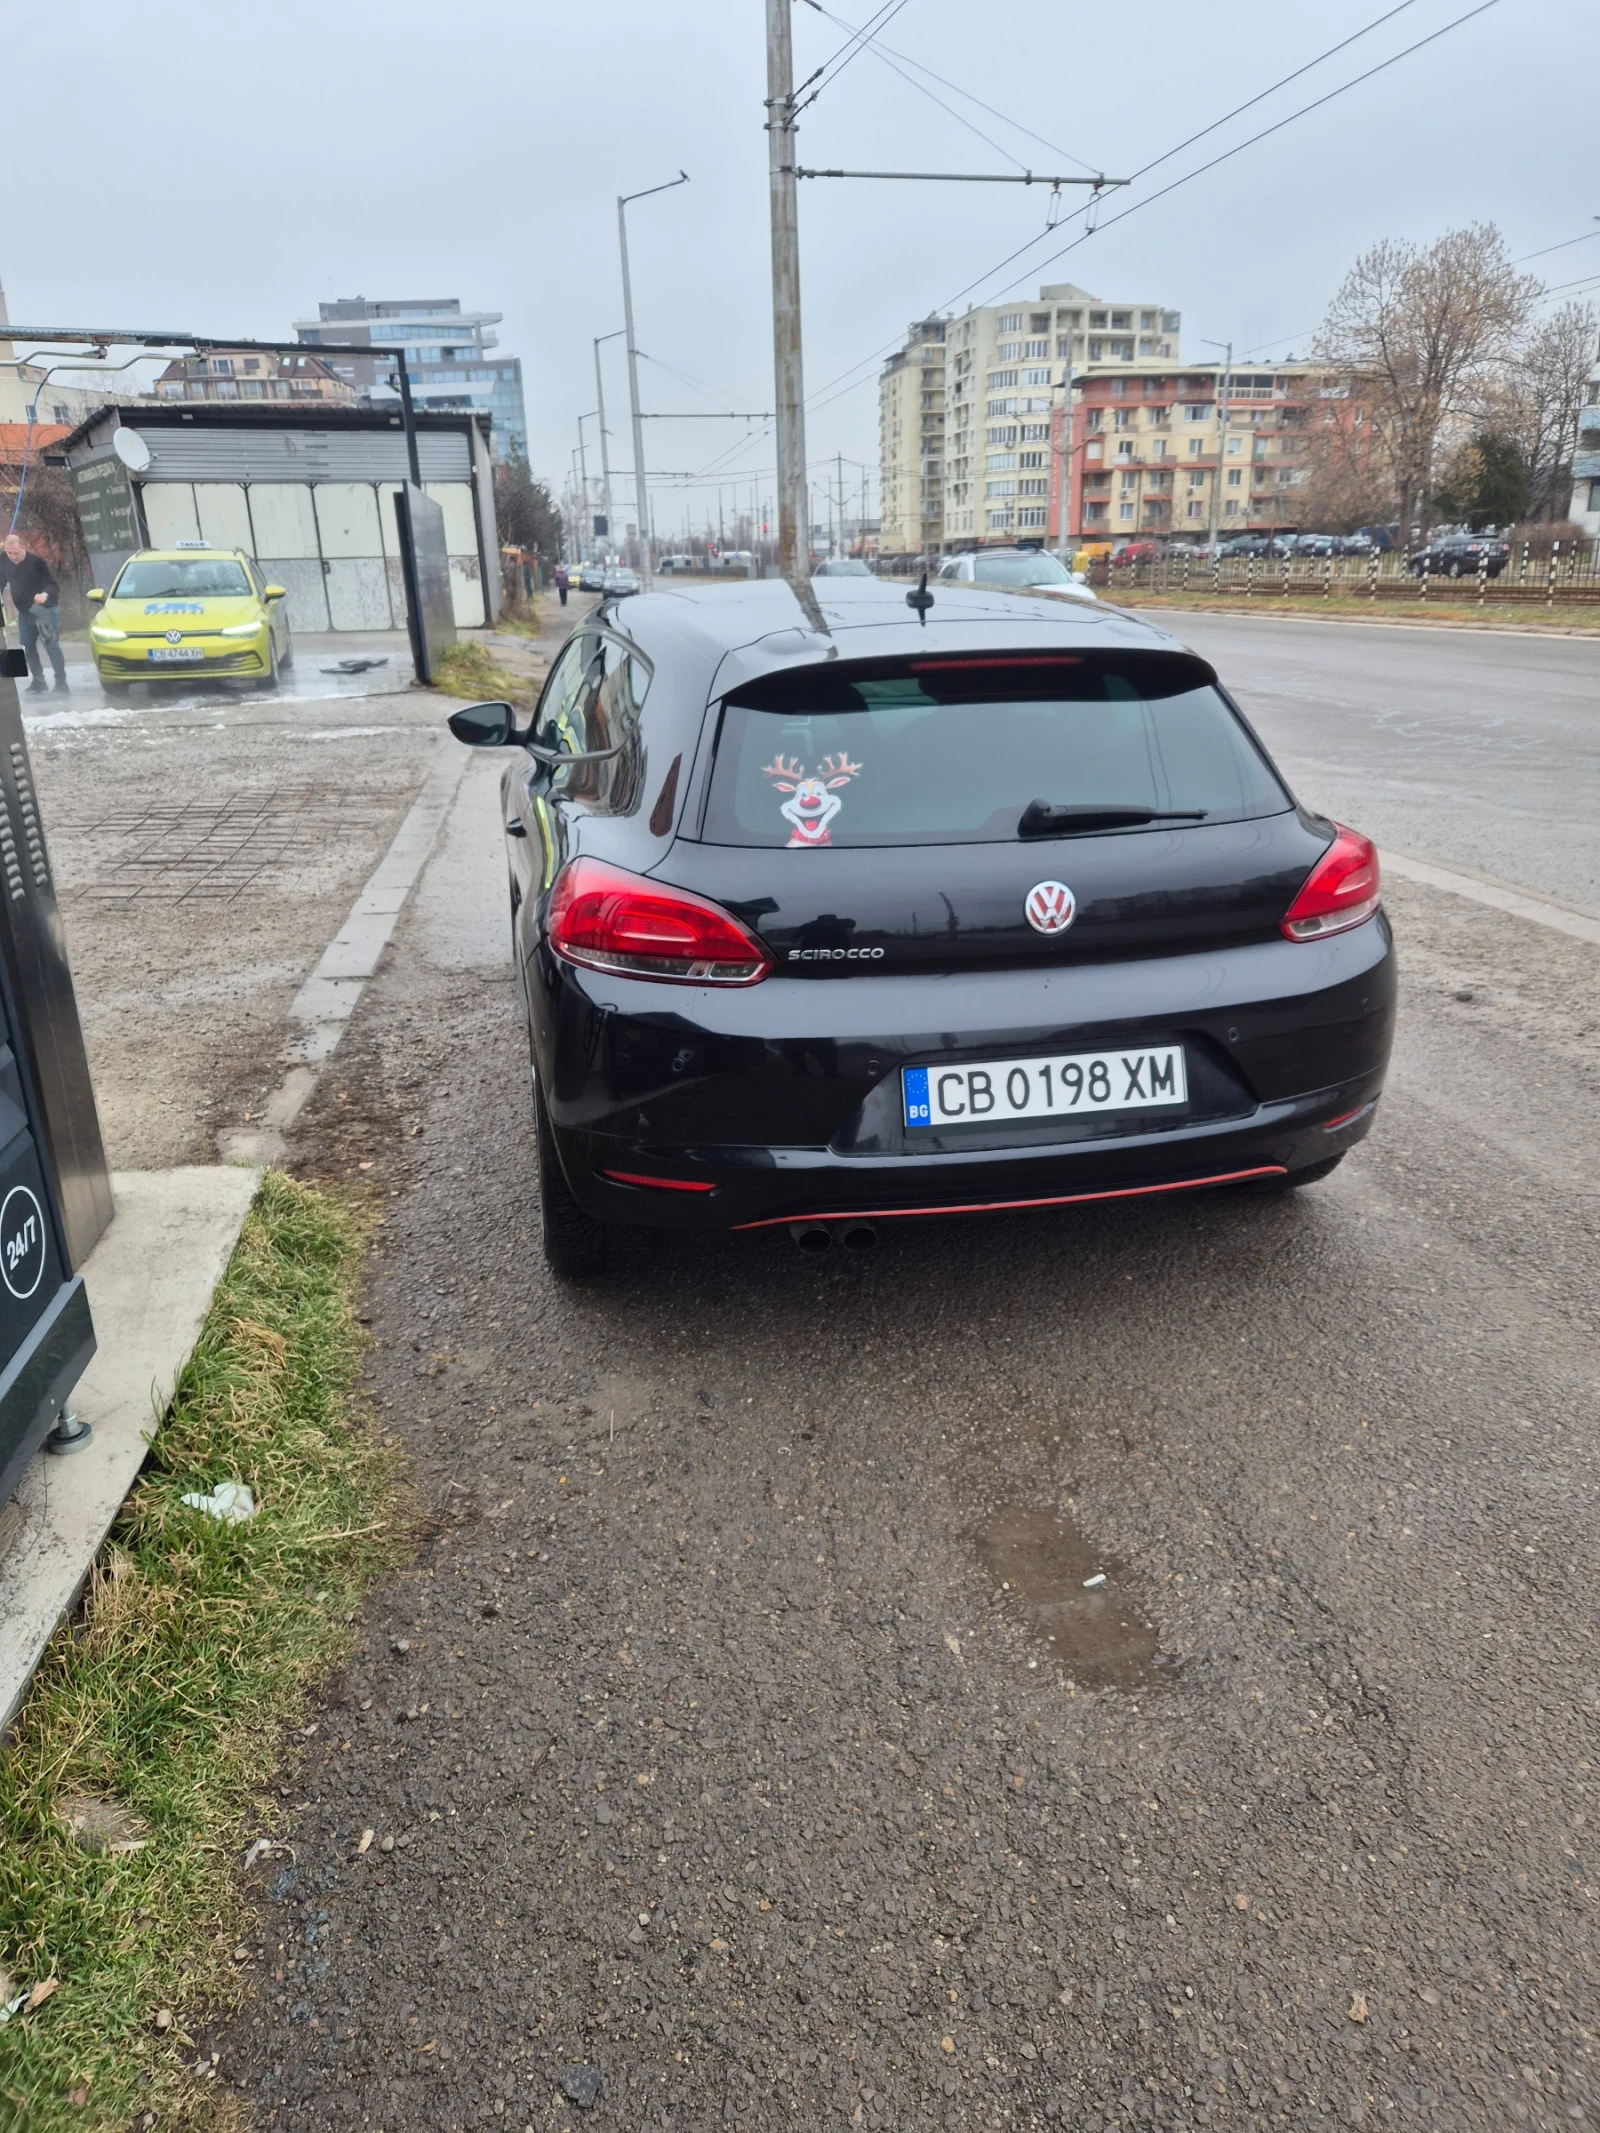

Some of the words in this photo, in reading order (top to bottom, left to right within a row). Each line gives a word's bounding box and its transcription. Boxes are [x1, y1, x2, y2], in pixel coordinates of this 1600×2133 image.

[788, 947, 885, 961] SCIROCCO
[937, 1070, 996, 1117] CB
[1006, 1059, 1112, 1111] 0198
[1121, 1053, 1177, 1102] XM
[909, 1104, 929, 1119] BG
[6, 1214, 36, 1271] 24/7
